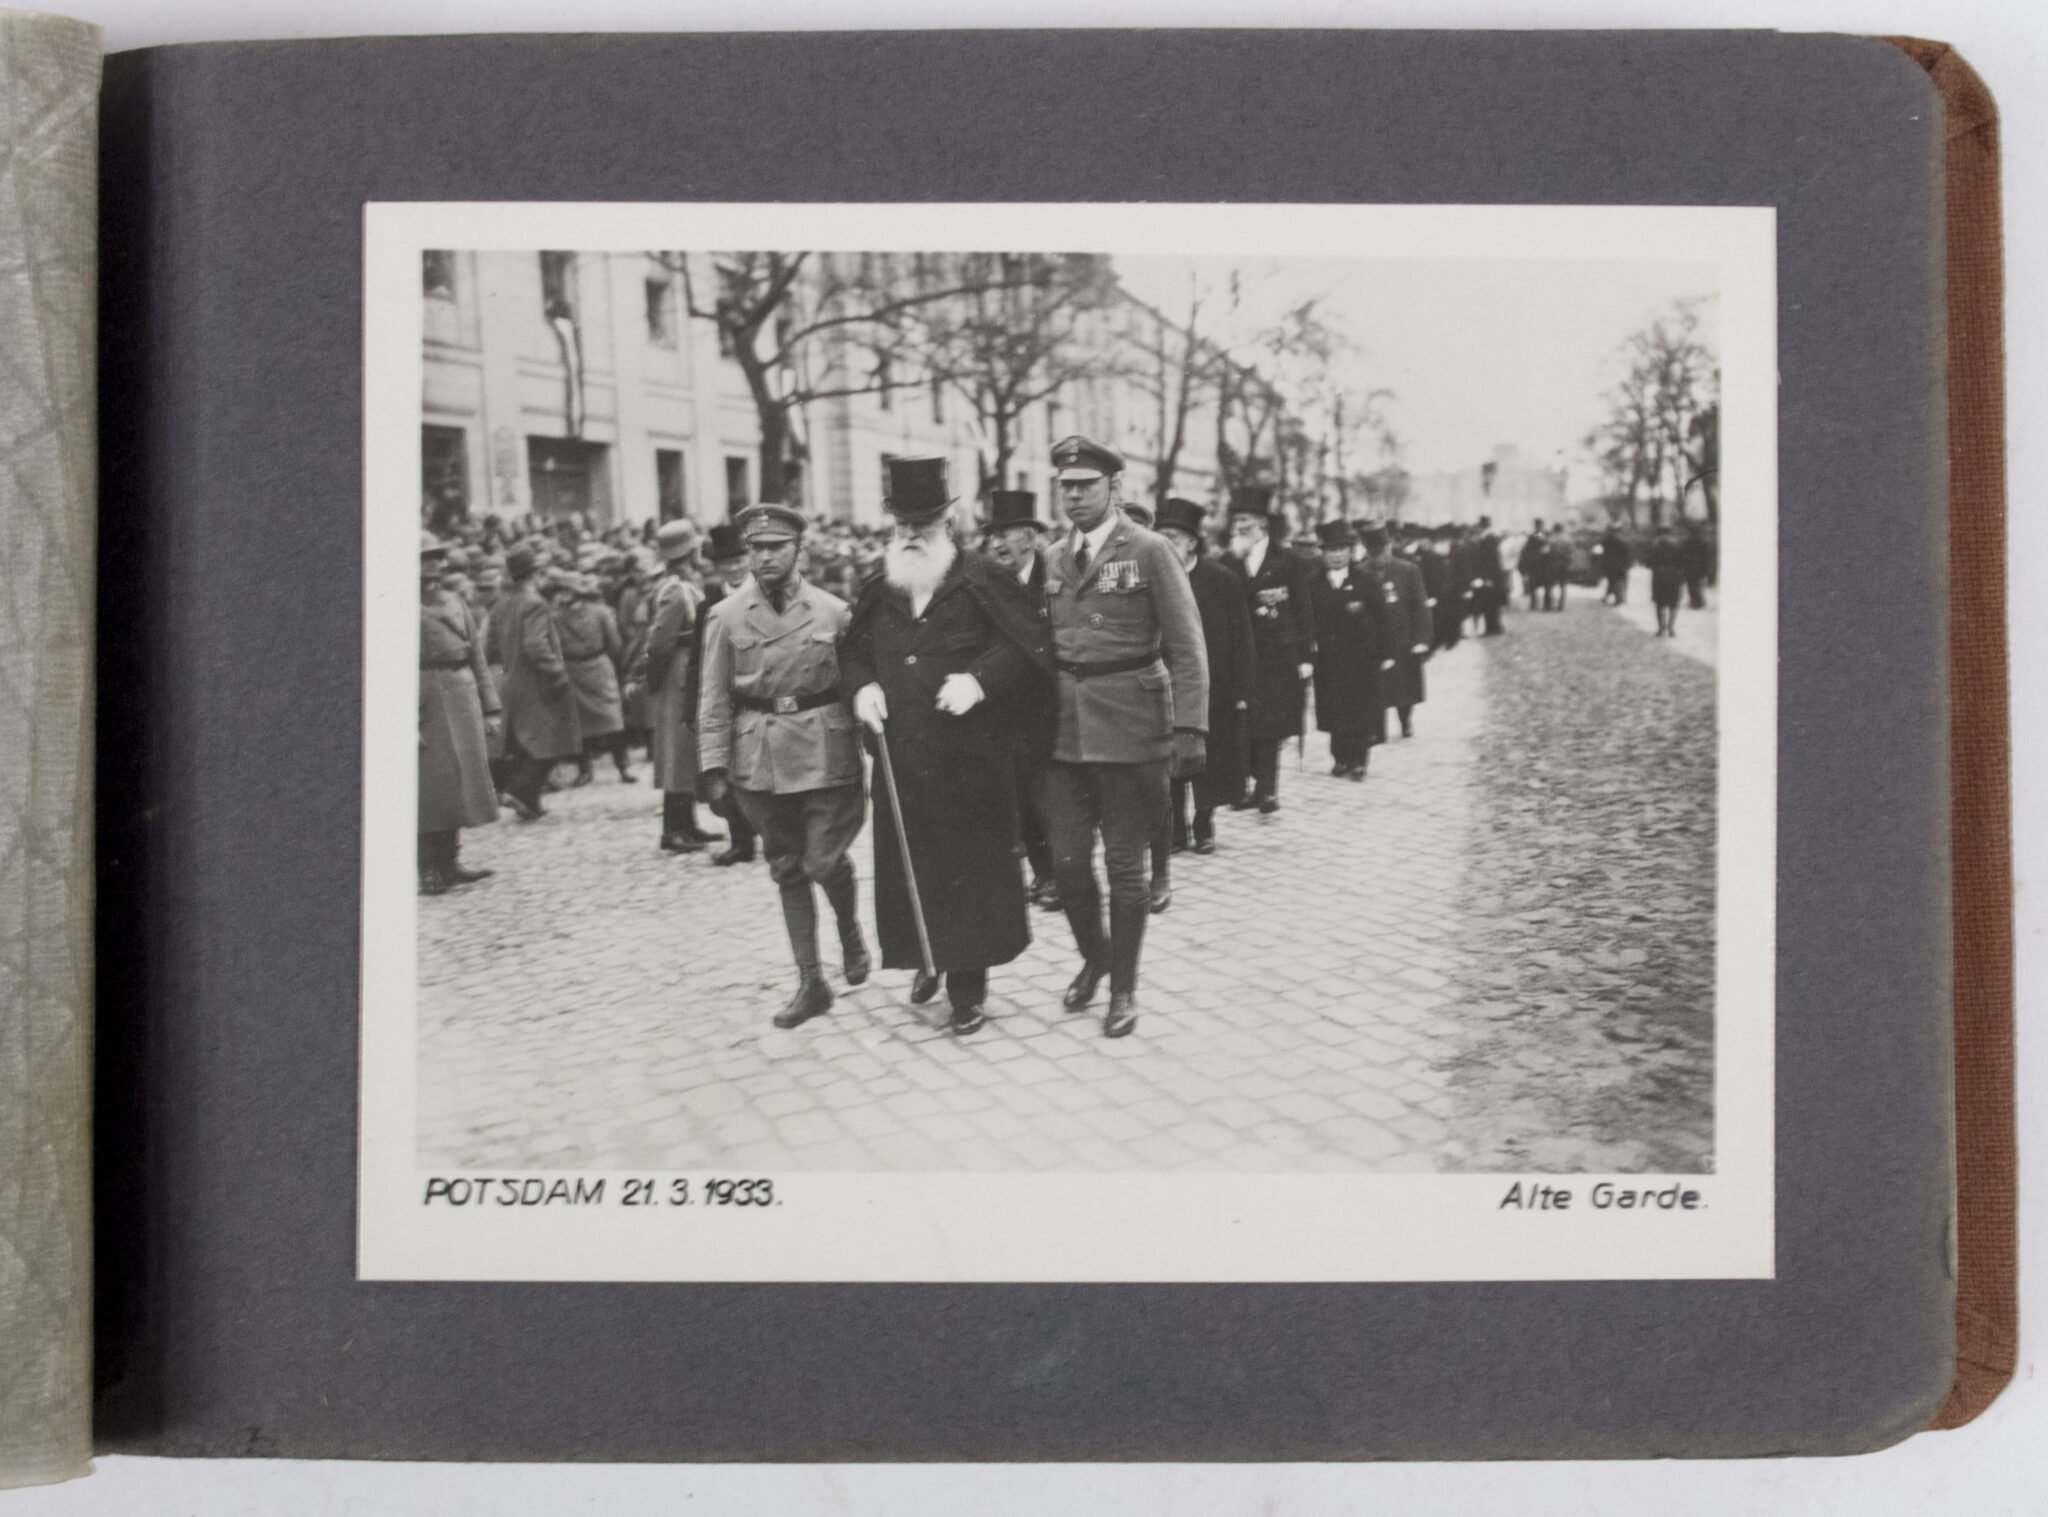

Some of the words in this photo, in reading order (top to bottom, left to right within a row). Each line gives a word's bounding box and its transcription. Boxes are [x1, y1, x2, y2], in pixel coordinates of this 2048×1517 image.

[423, 1177, 606, 1207] POTSDAM
[1499, 1181, 1572, 1210] Alte
[1591, 1182, 1709, 1210] Garde.
